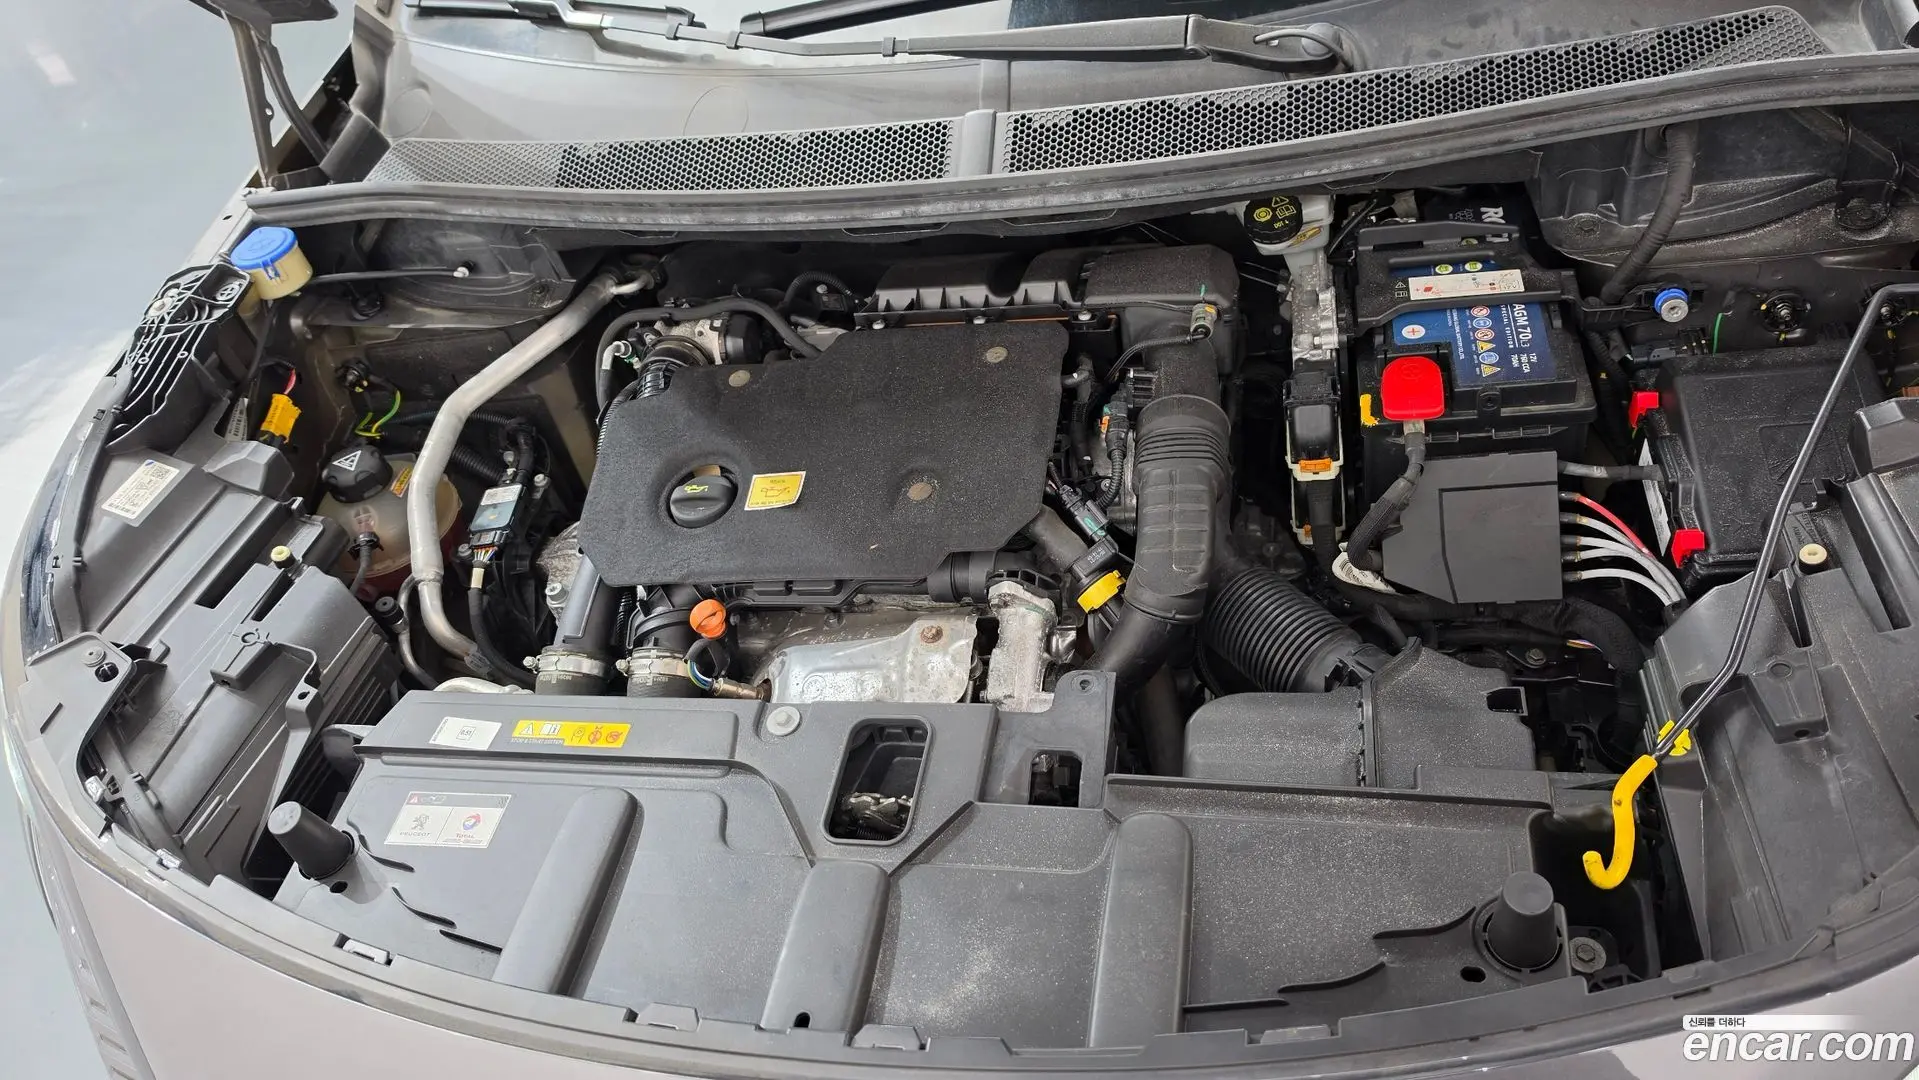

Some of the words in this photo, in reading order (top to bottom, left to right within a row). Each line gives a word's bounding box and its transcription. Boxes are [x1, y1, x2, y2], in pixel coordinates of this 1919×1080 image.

[1512, 303, 1529, 326] AGM
[1500, 305, 1509, 324] SPECIAL
[1505, 327, 1514, 348] EDITION
[1529, 352, 1538, 363] 12V
